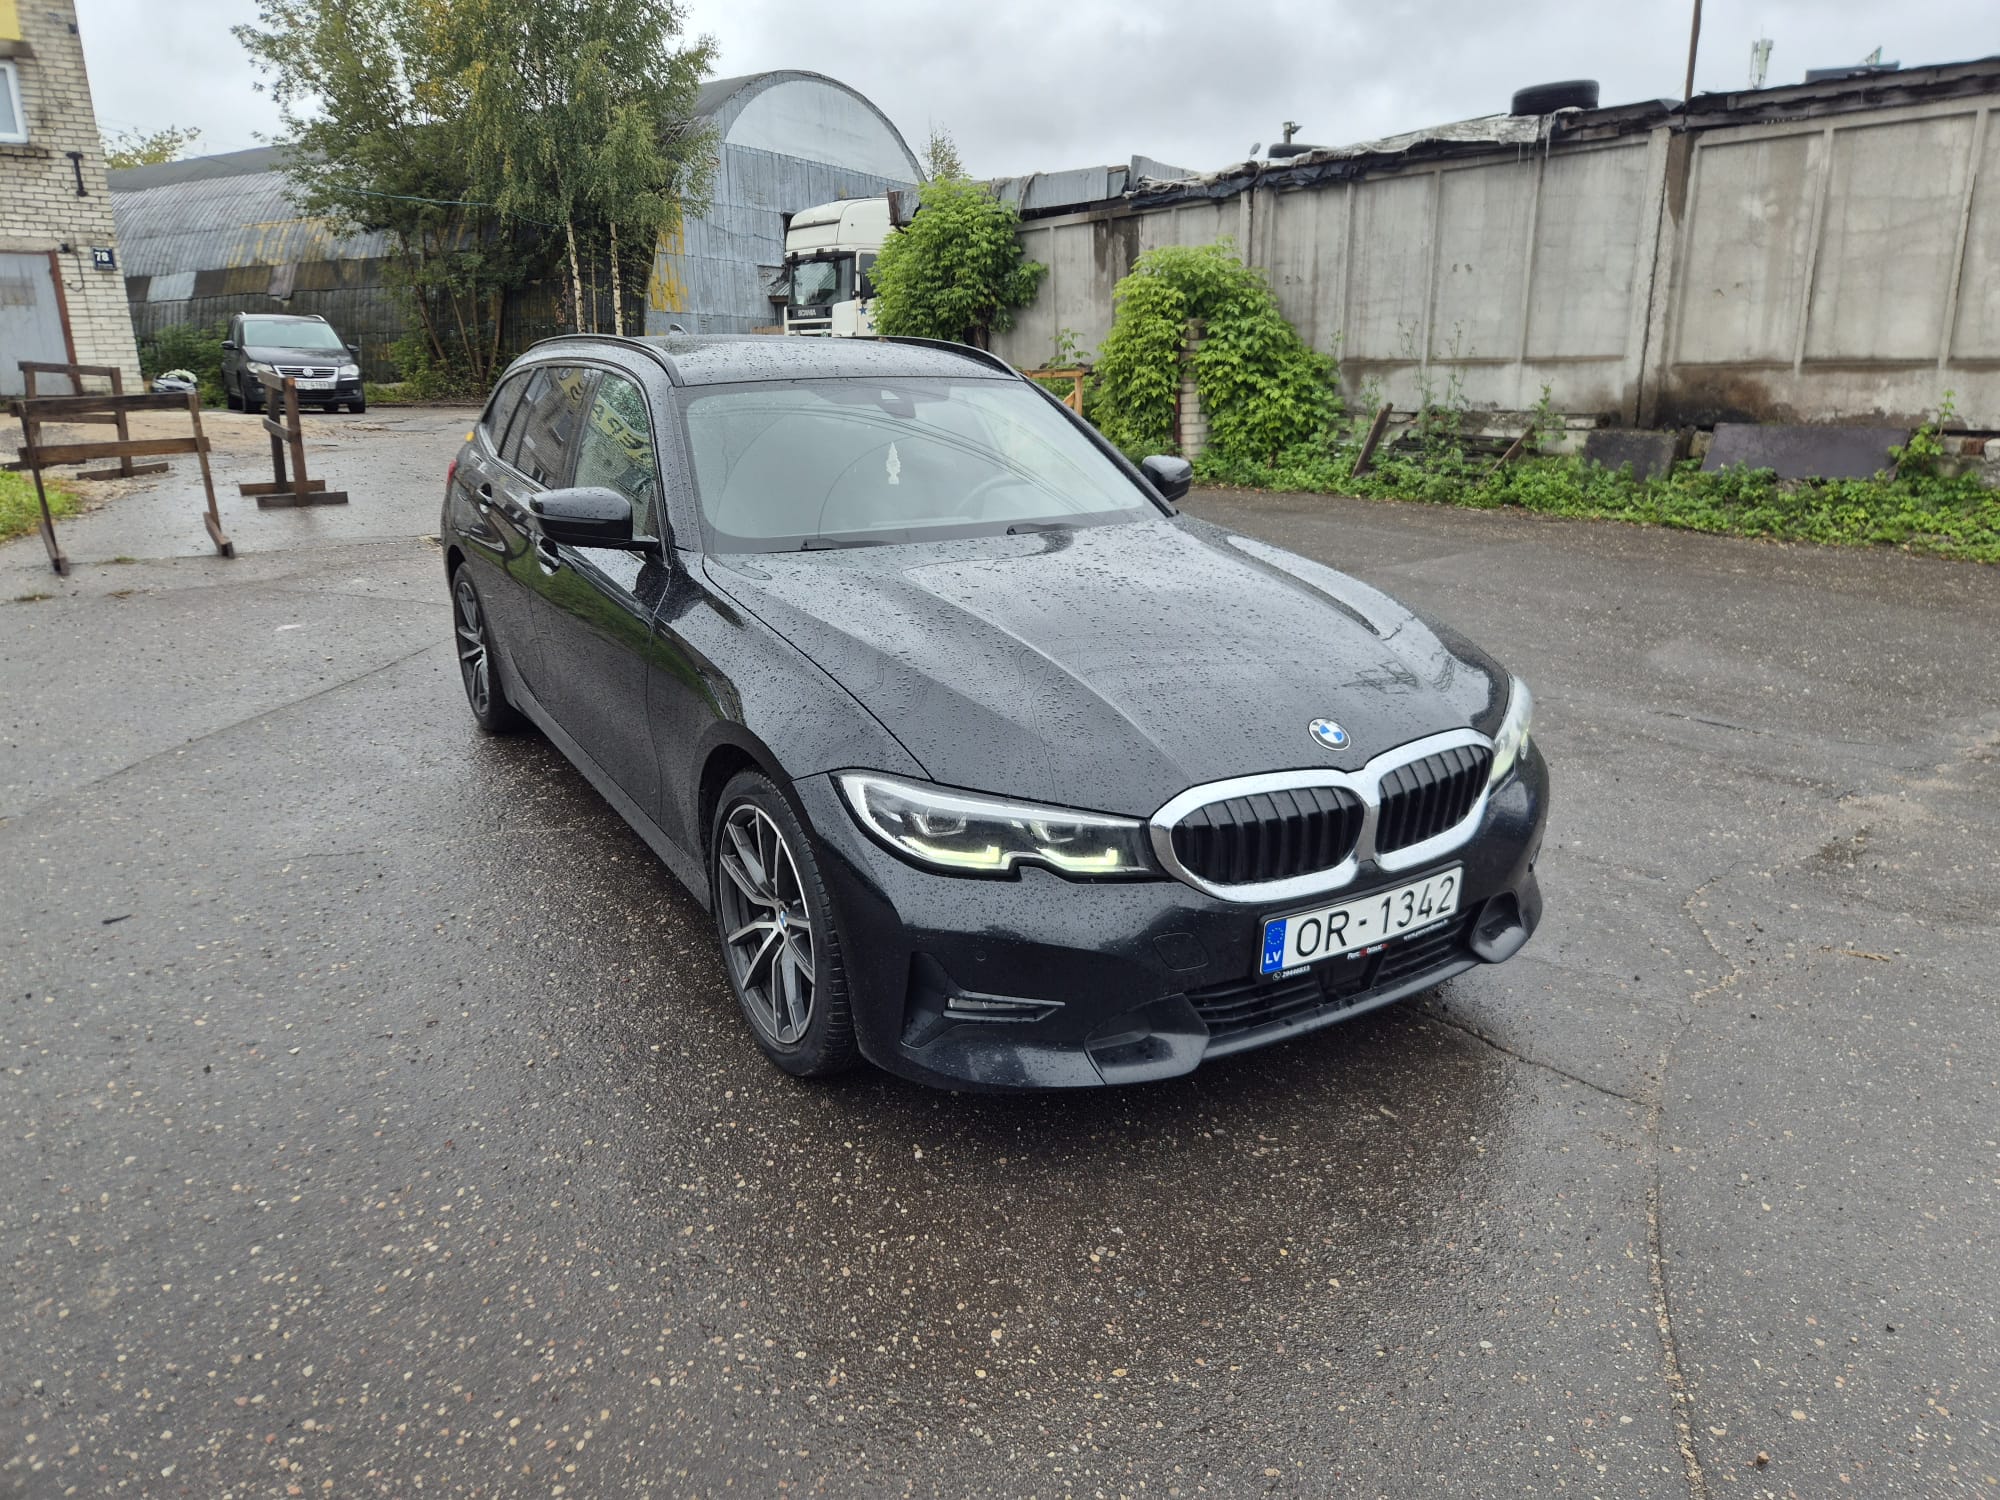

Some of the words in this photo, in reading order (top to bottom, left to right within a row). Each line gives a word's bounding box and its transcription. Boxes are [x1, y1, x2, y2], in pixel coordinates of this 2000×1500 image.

[94, 251, 110, 262] 78
[1296, 876, 1455, 956] OR-1342
[1265, 951, 1282, 965] LV
